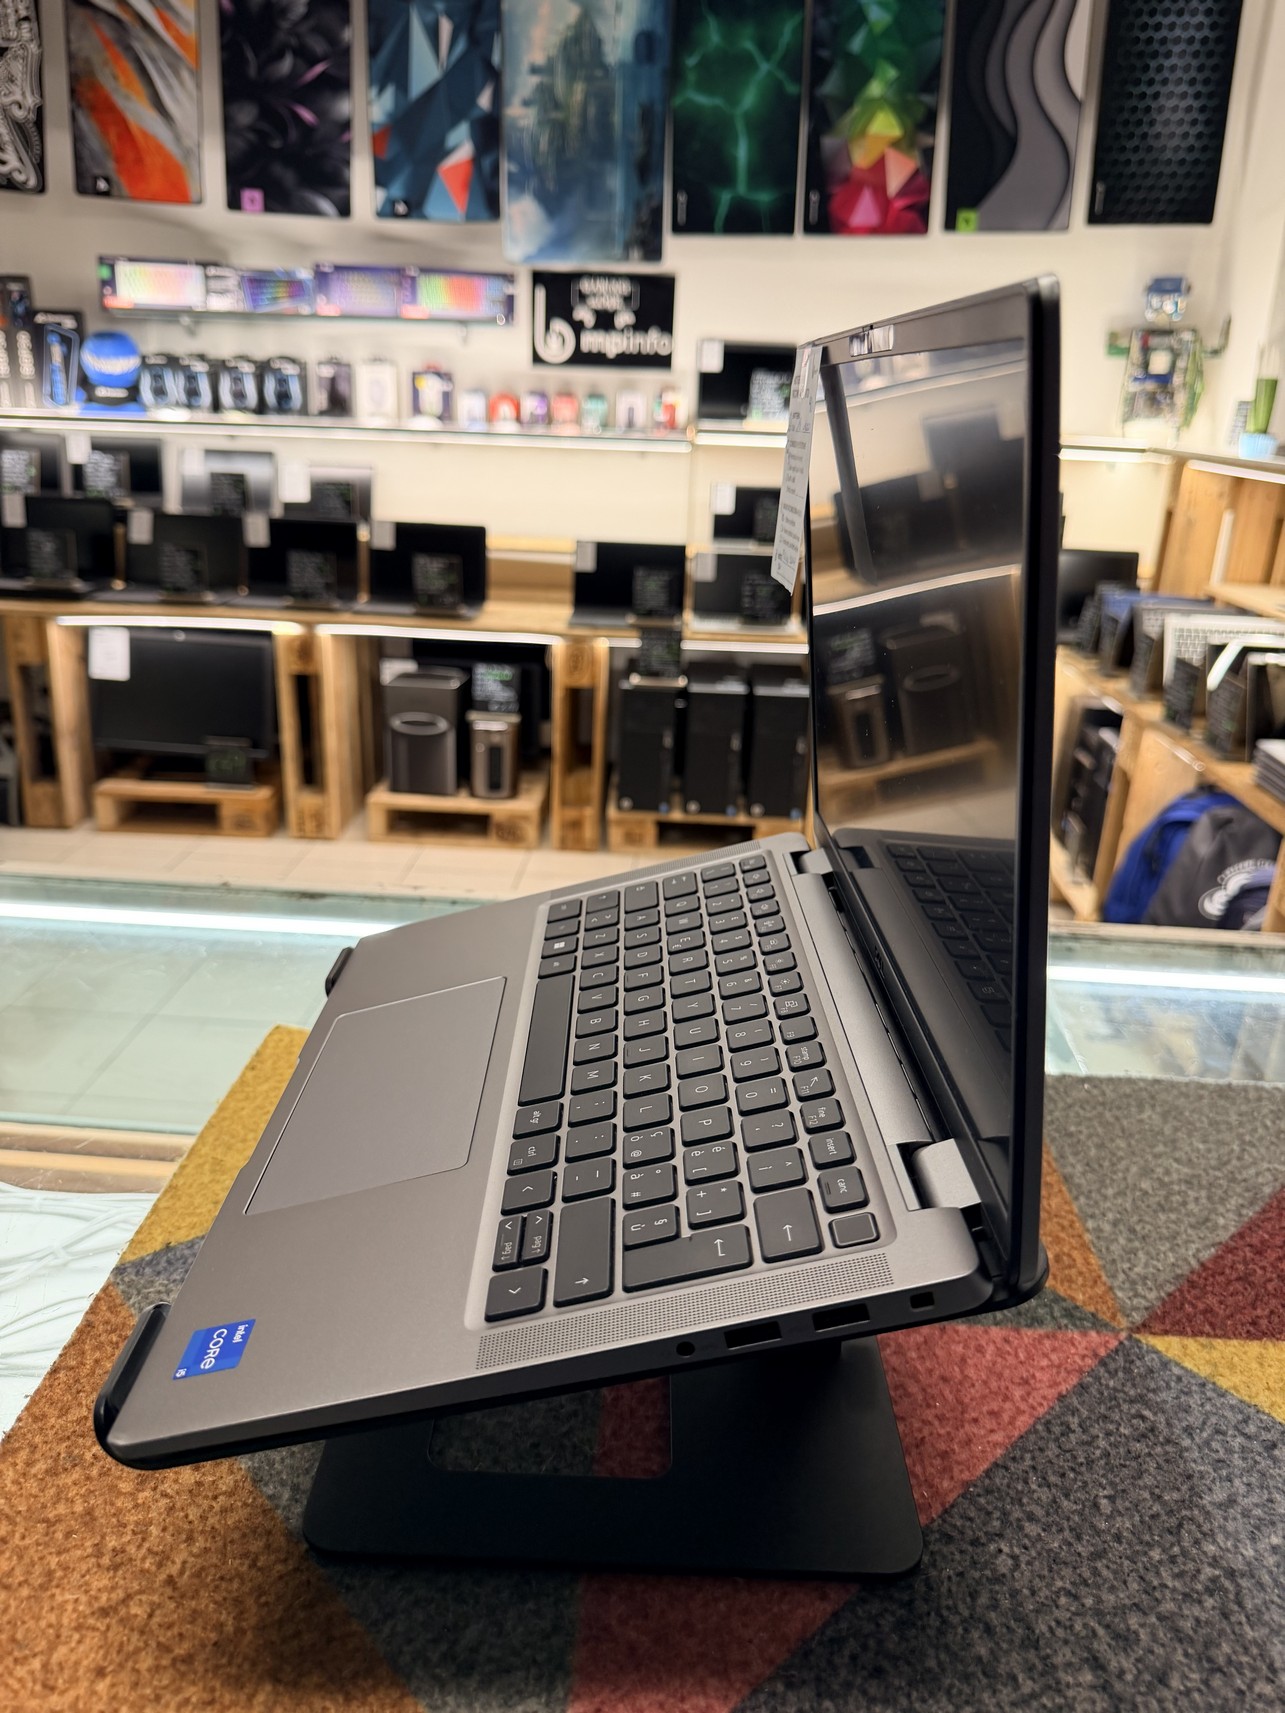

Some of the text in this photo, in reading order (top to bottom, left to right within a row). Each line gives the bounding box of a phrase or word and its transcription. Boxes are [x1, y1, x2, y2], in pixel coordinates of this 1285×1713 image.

[637, 994, 650, 1002] G
[589, 1017, 602, 1025] B
[638, 1019, 650, 1027] H
[689, 1027, 702, 1035] U
[588, 1042, 601, 1051] N
[800, 1046, 810, 1061] stamp
[792, 1055, 802, 1065] F10
[586, 1070, 599, 1080] M
[639, 1073, 652, 1082] K
[694, 1085, 709, 1094] O
[800, 1085, 810, 1094] F11
[639, 1105, 653, 1114] L
[817, 1106, 827, 1118] fine
[698, 1118, 713, 1126] P
[808, 1115, 819, 1125] F12
[826, 1137, 837, 1156] insert
[527, 1146, 537, 1157] ctrl
[630, 1149, 643, 1158] @
[836, 1178, 848, 1194] canc
[630, 1223, 646, 1232] ù
[232, 1324, 249, 1343] intel
[175, 1368, 187, 1378] i5
